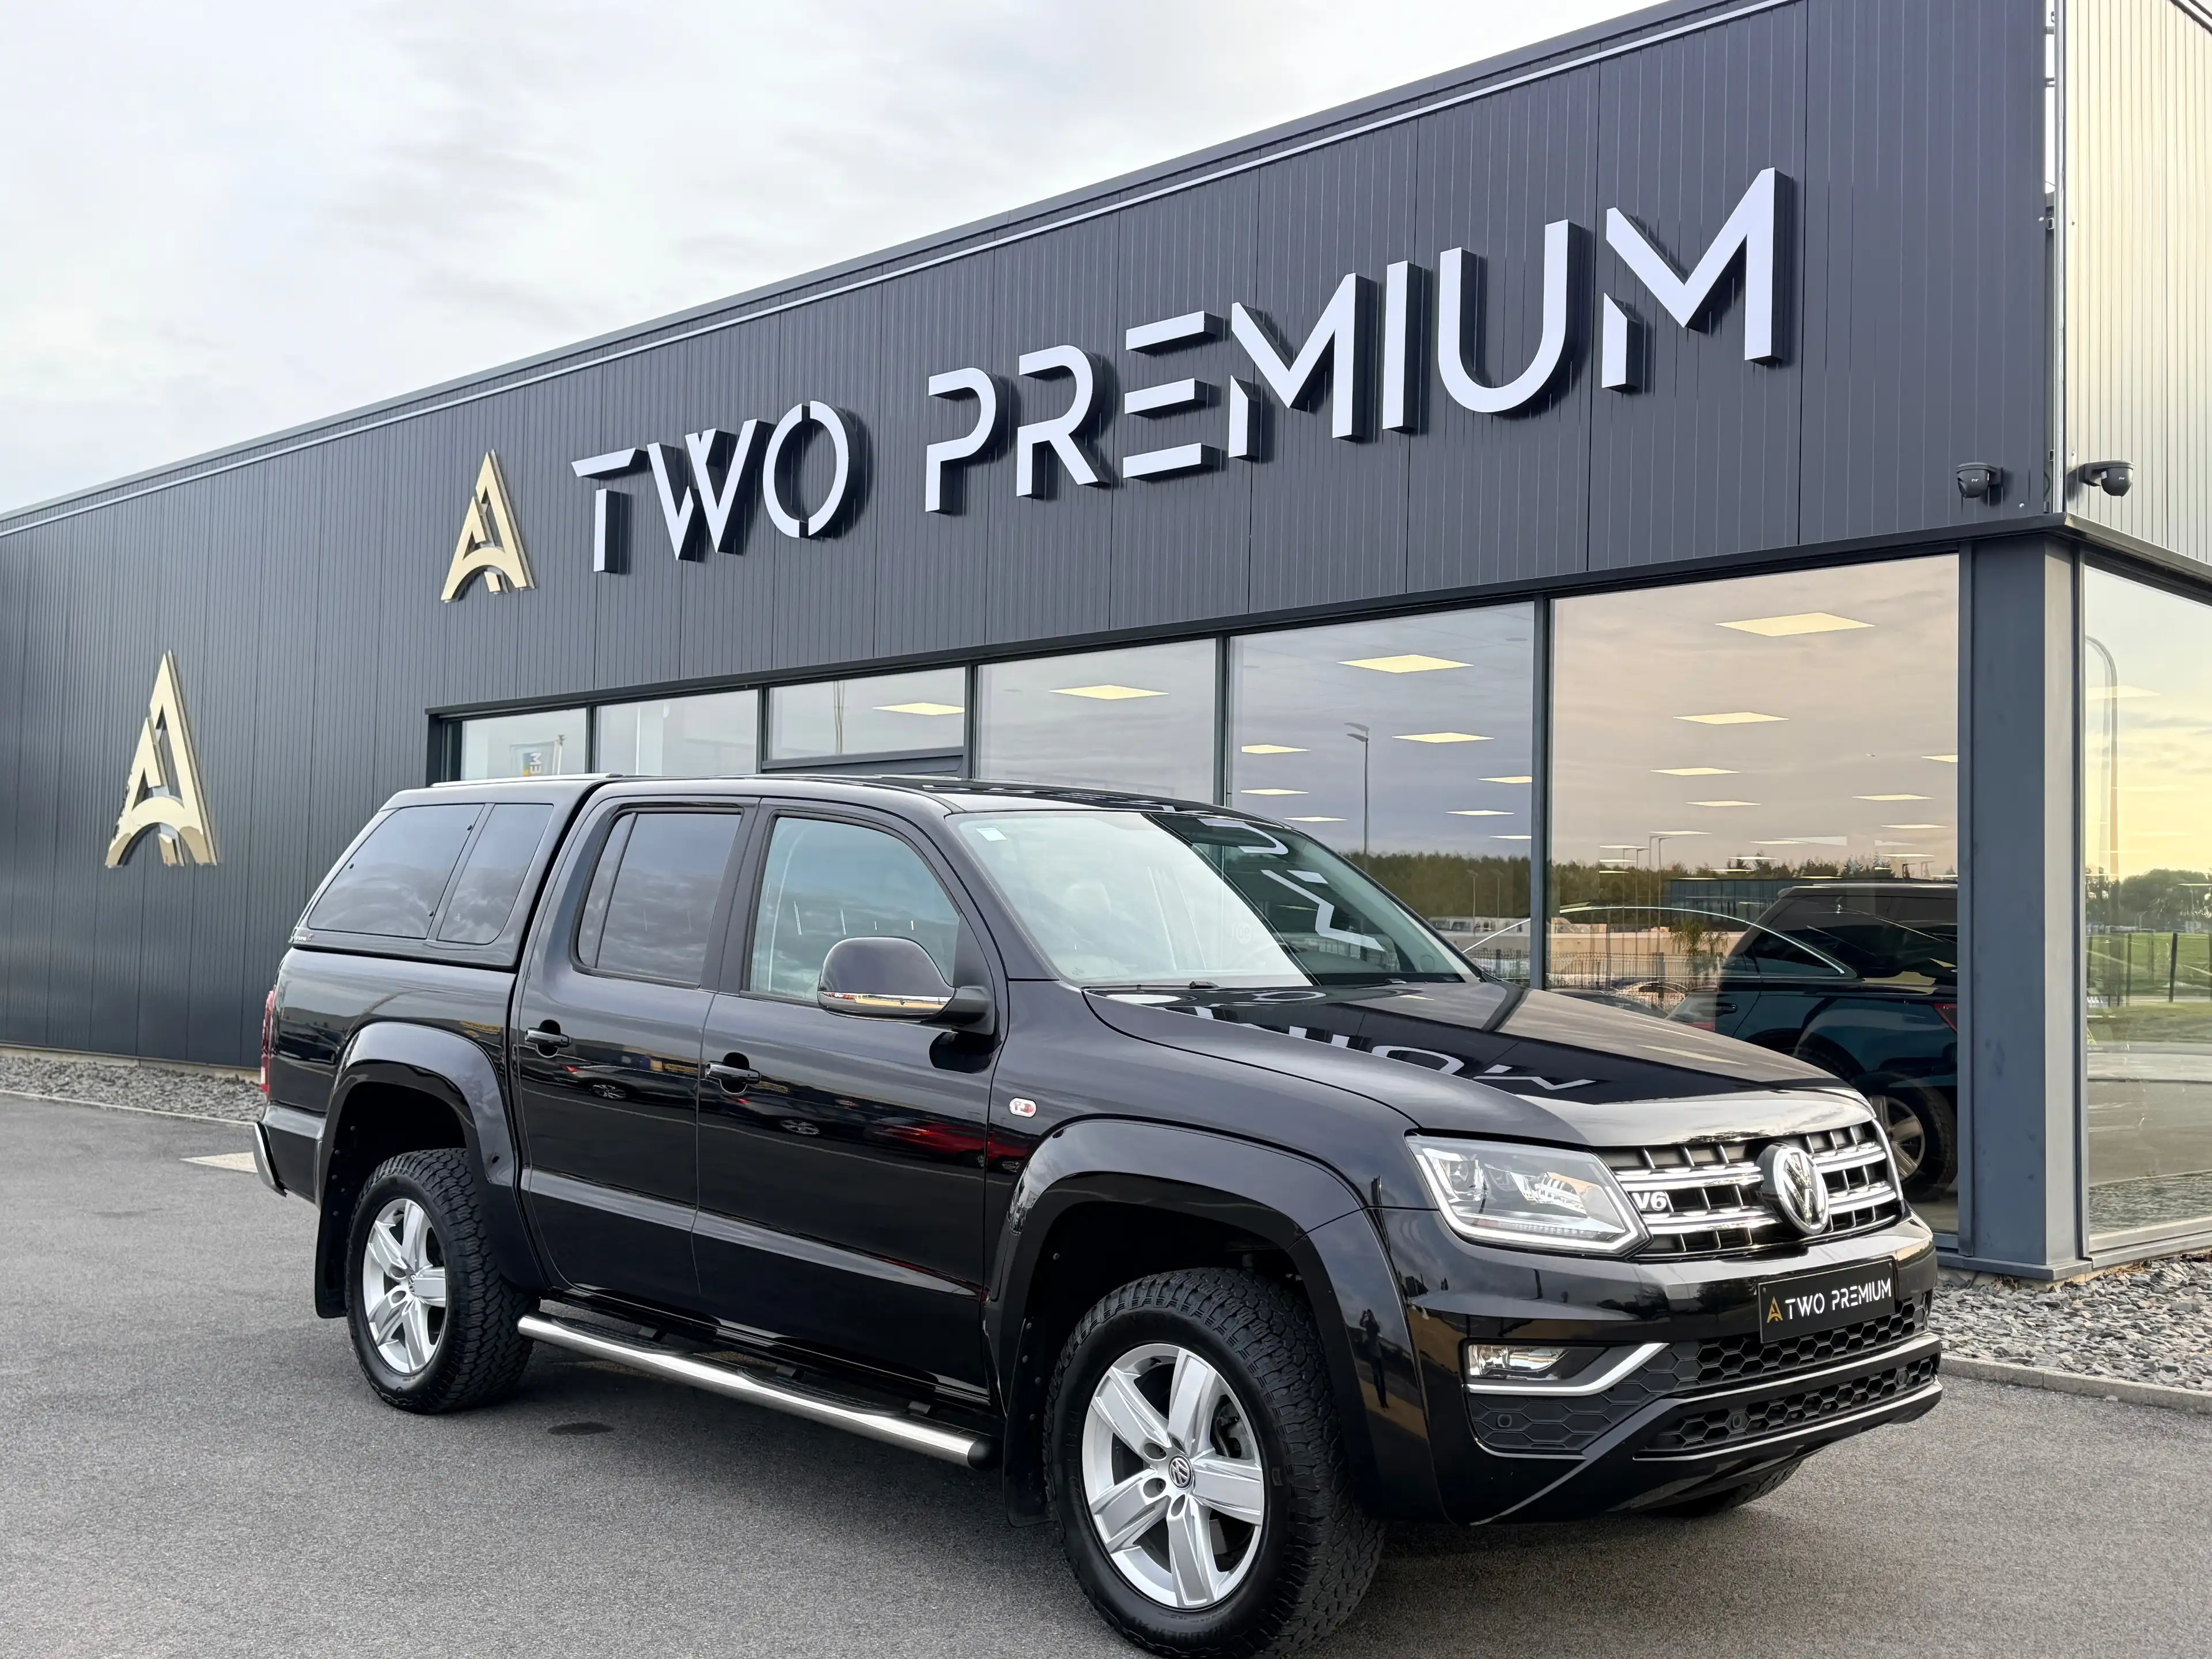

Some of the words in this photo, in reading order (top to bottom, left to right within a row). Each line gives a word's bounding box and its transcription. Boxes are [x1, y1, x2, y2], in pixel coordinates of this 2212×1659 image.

[571, 400, 849, 571] TWO
[926, 166, 1777, 512] PREMIUM
[1632, 1191, 1667, 1211] V6
[1785, 1293, 1825, 1320] TWO
[1832, 1277, 1892, 1310] PREMIUM
